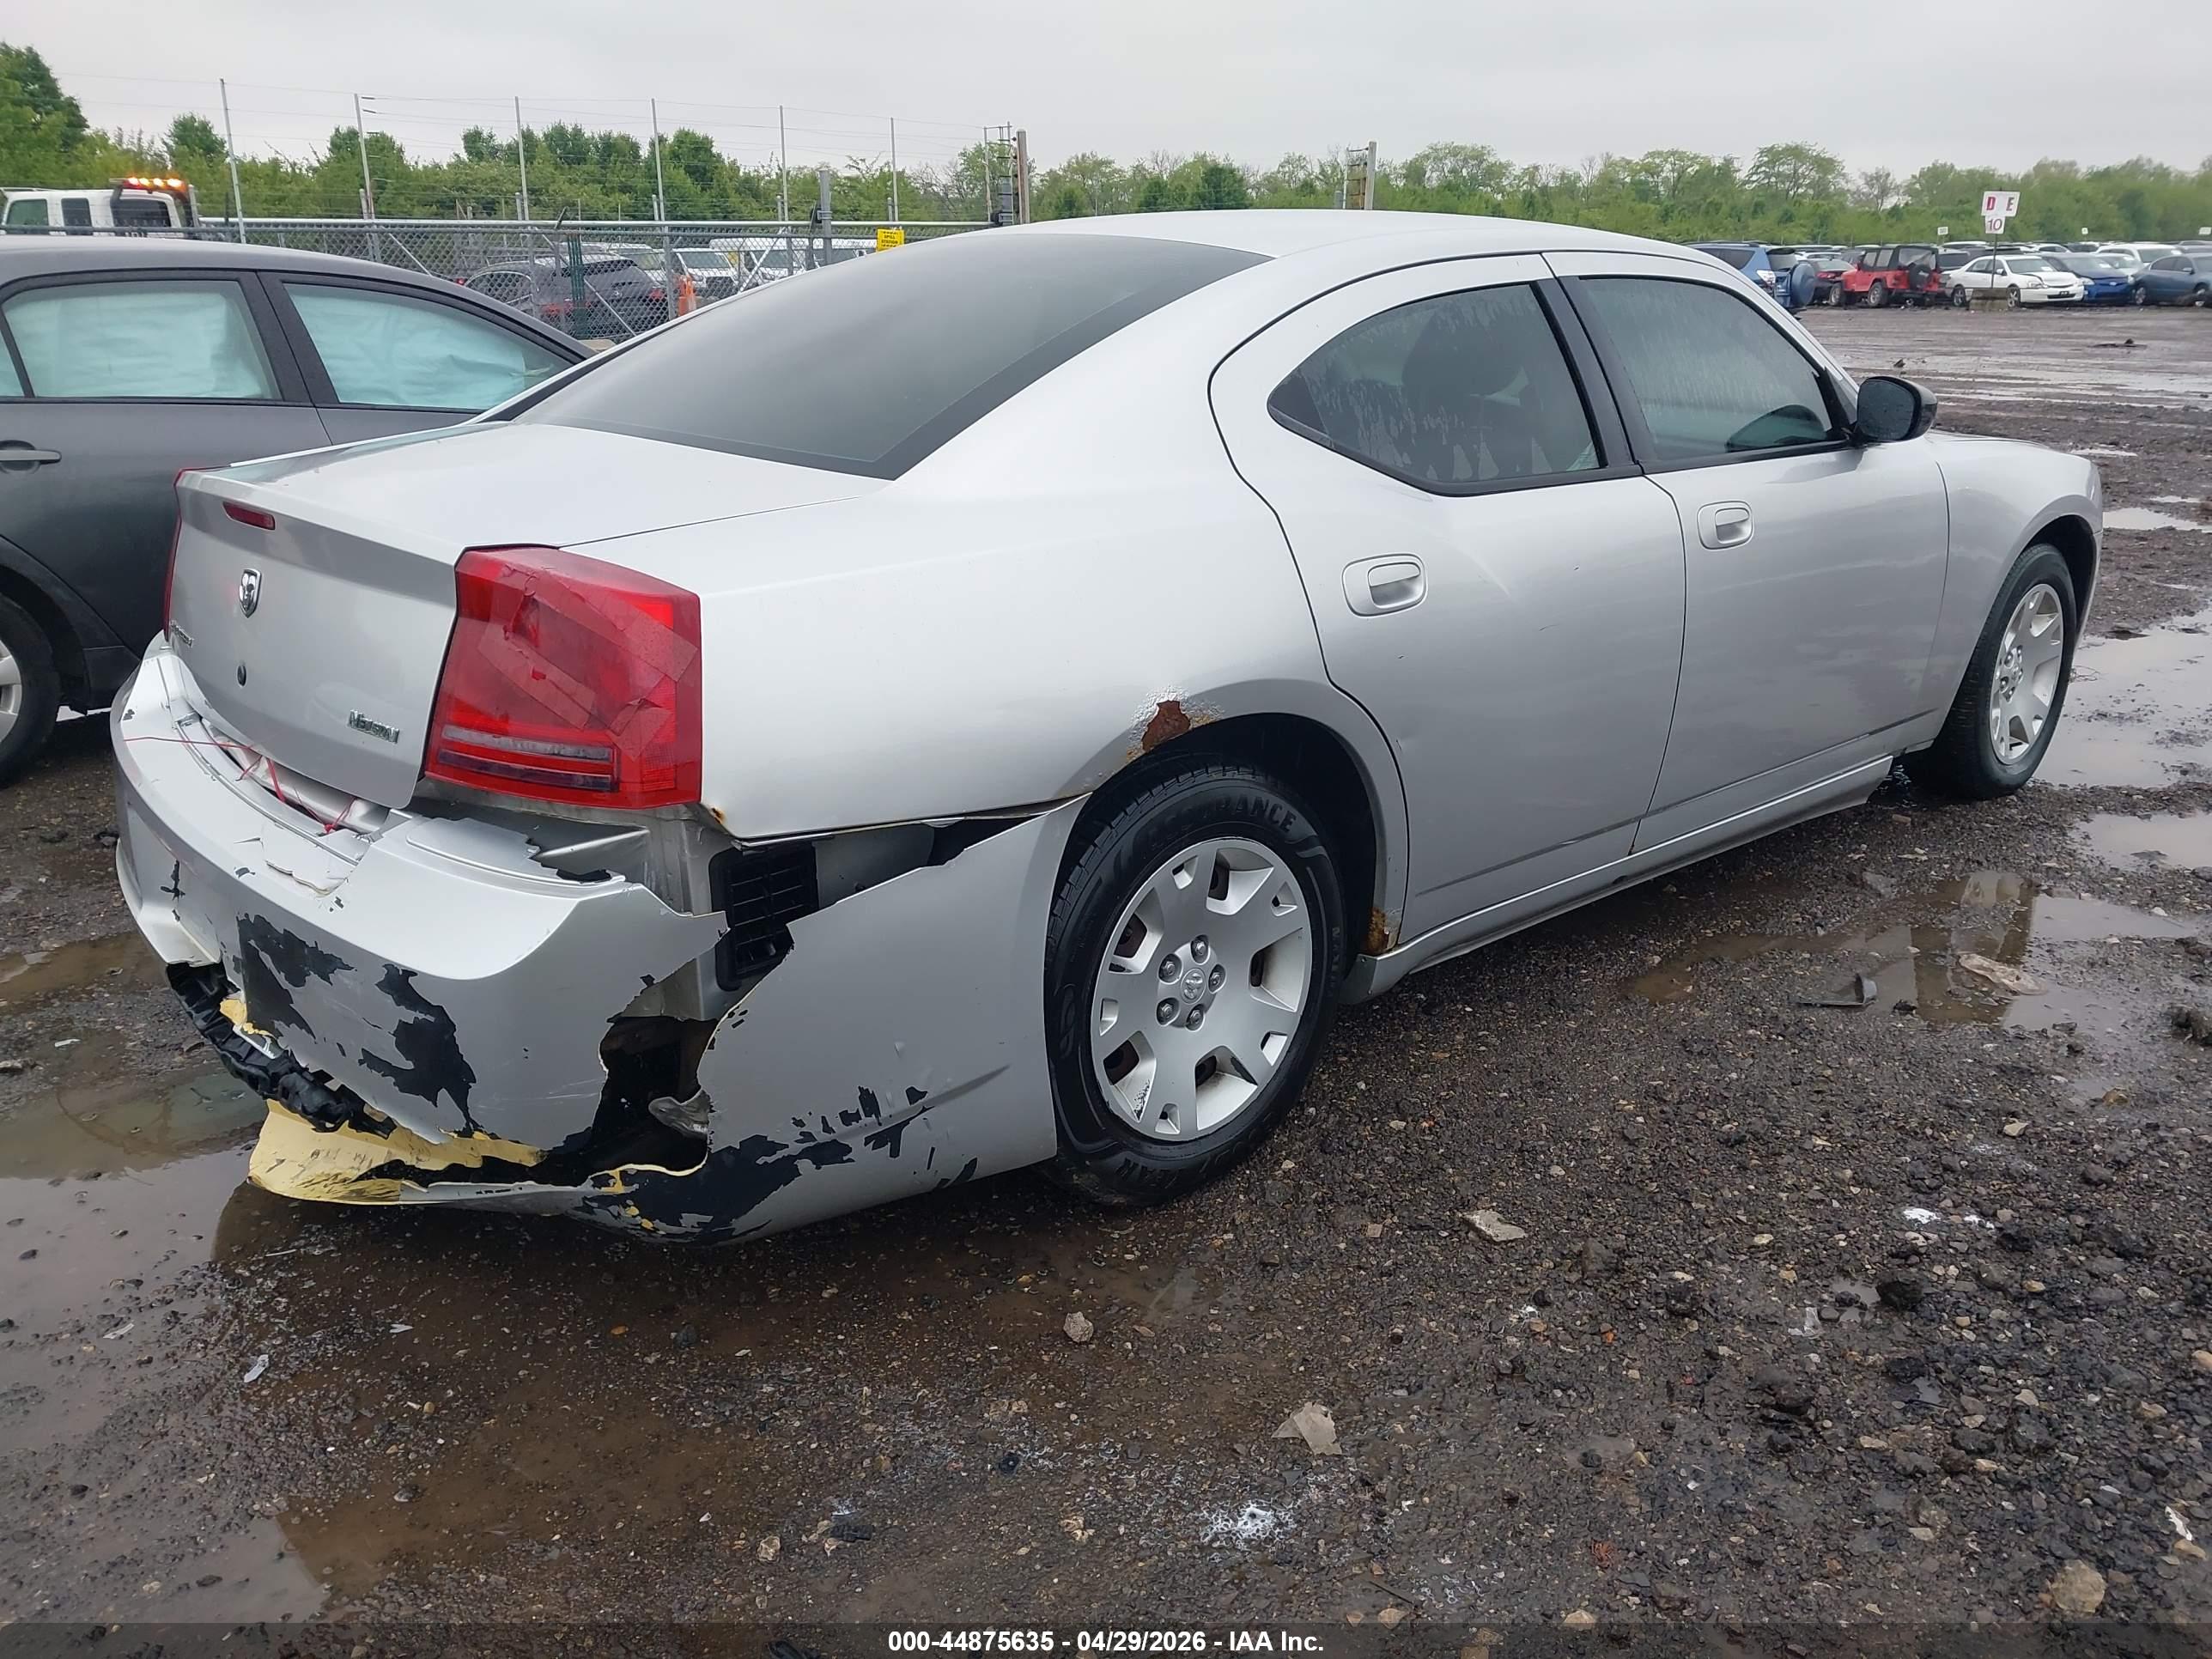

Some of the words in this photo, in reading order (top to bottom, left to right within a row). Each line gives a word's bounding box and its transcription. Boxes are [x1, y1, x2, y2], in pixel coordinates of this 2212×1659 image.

[1986, 196, 1996, 211] D
[2006, 197, 2014, 211] E
[1987, 218, 2002, 231] 10
